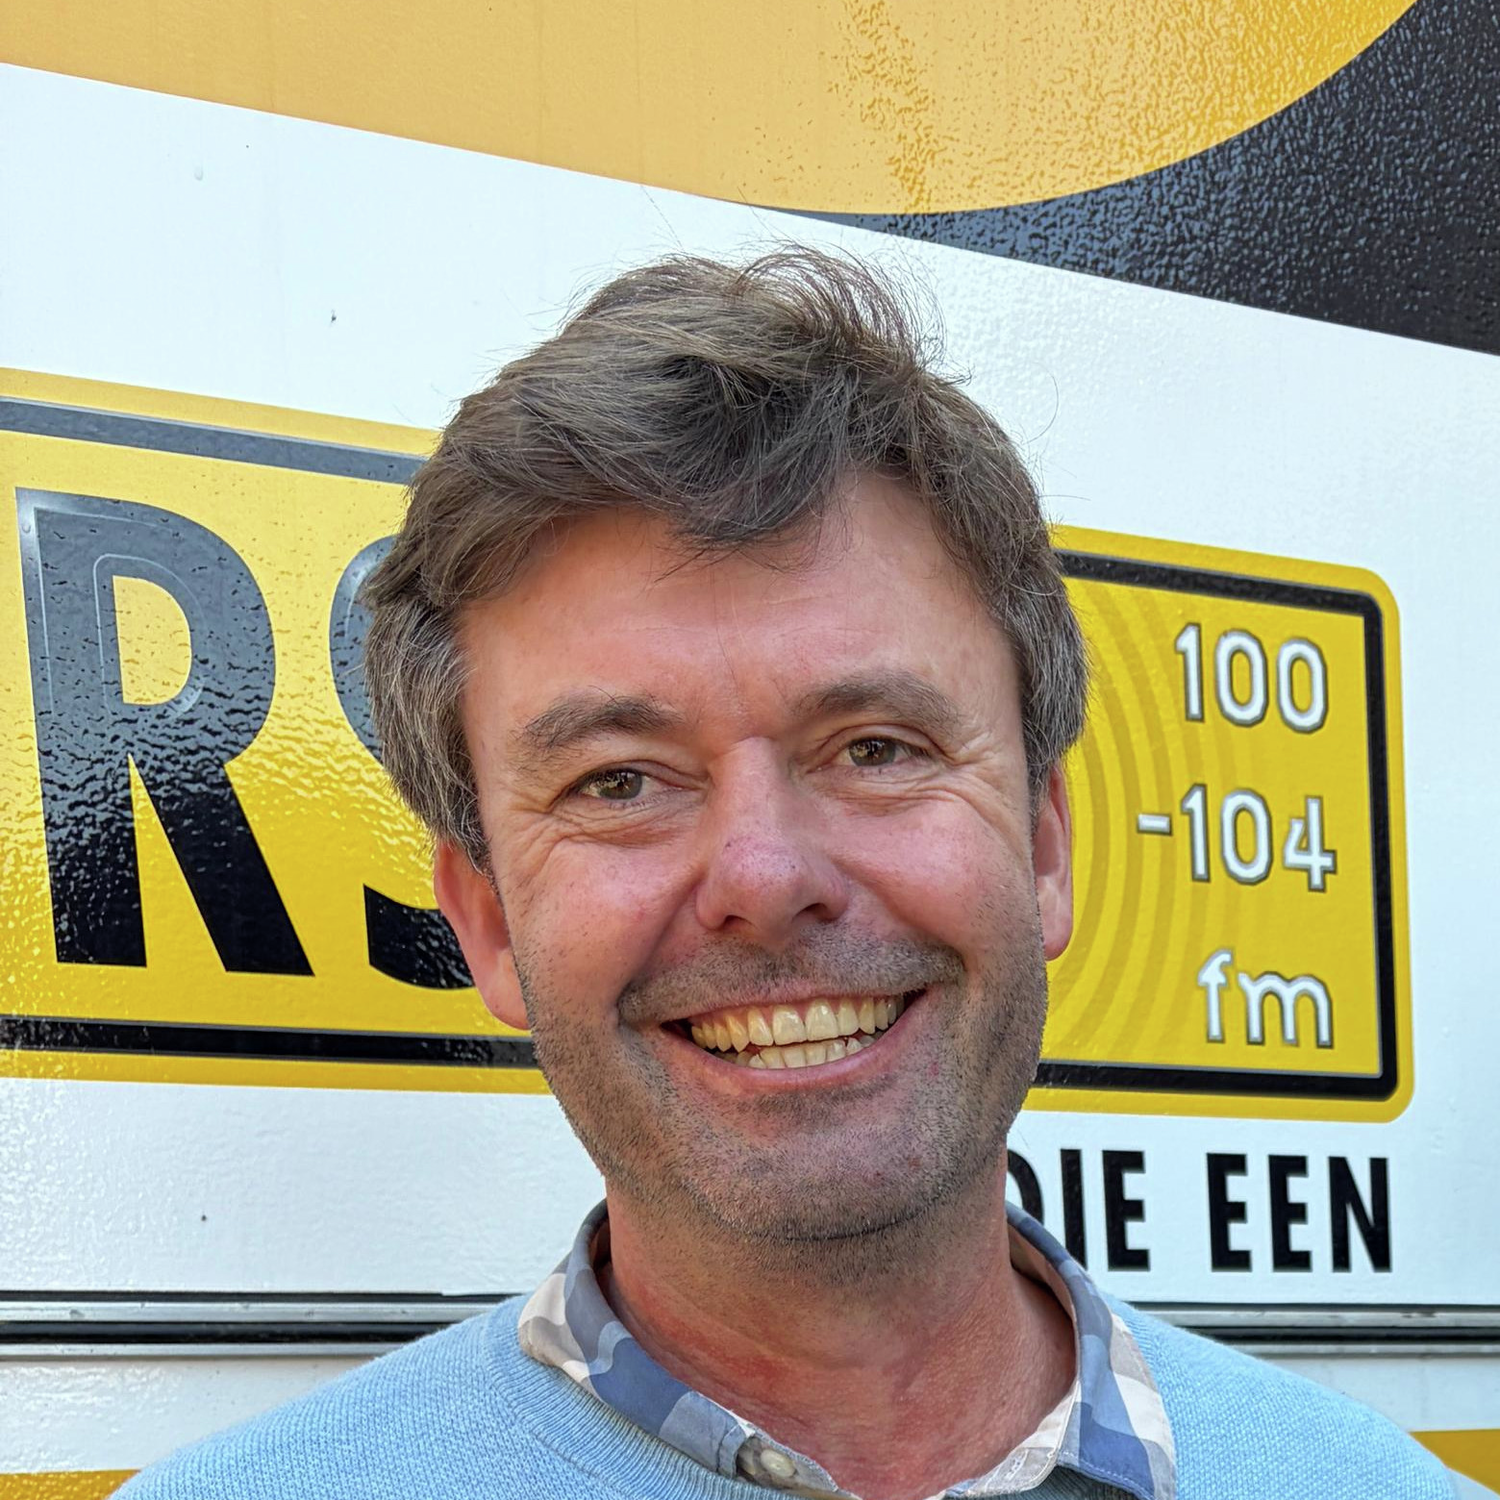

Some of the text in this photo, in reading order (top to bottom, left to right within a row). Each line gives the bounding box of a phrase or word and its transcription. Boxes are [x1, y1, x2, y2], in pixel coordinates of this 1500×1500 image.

[1176, 623, 1328, 733] 100
[1137, 783, 1337, 892] -104
[1198, 949, 1334, 1049] fm
[1206, 1152, 1392, 1273] EEN
